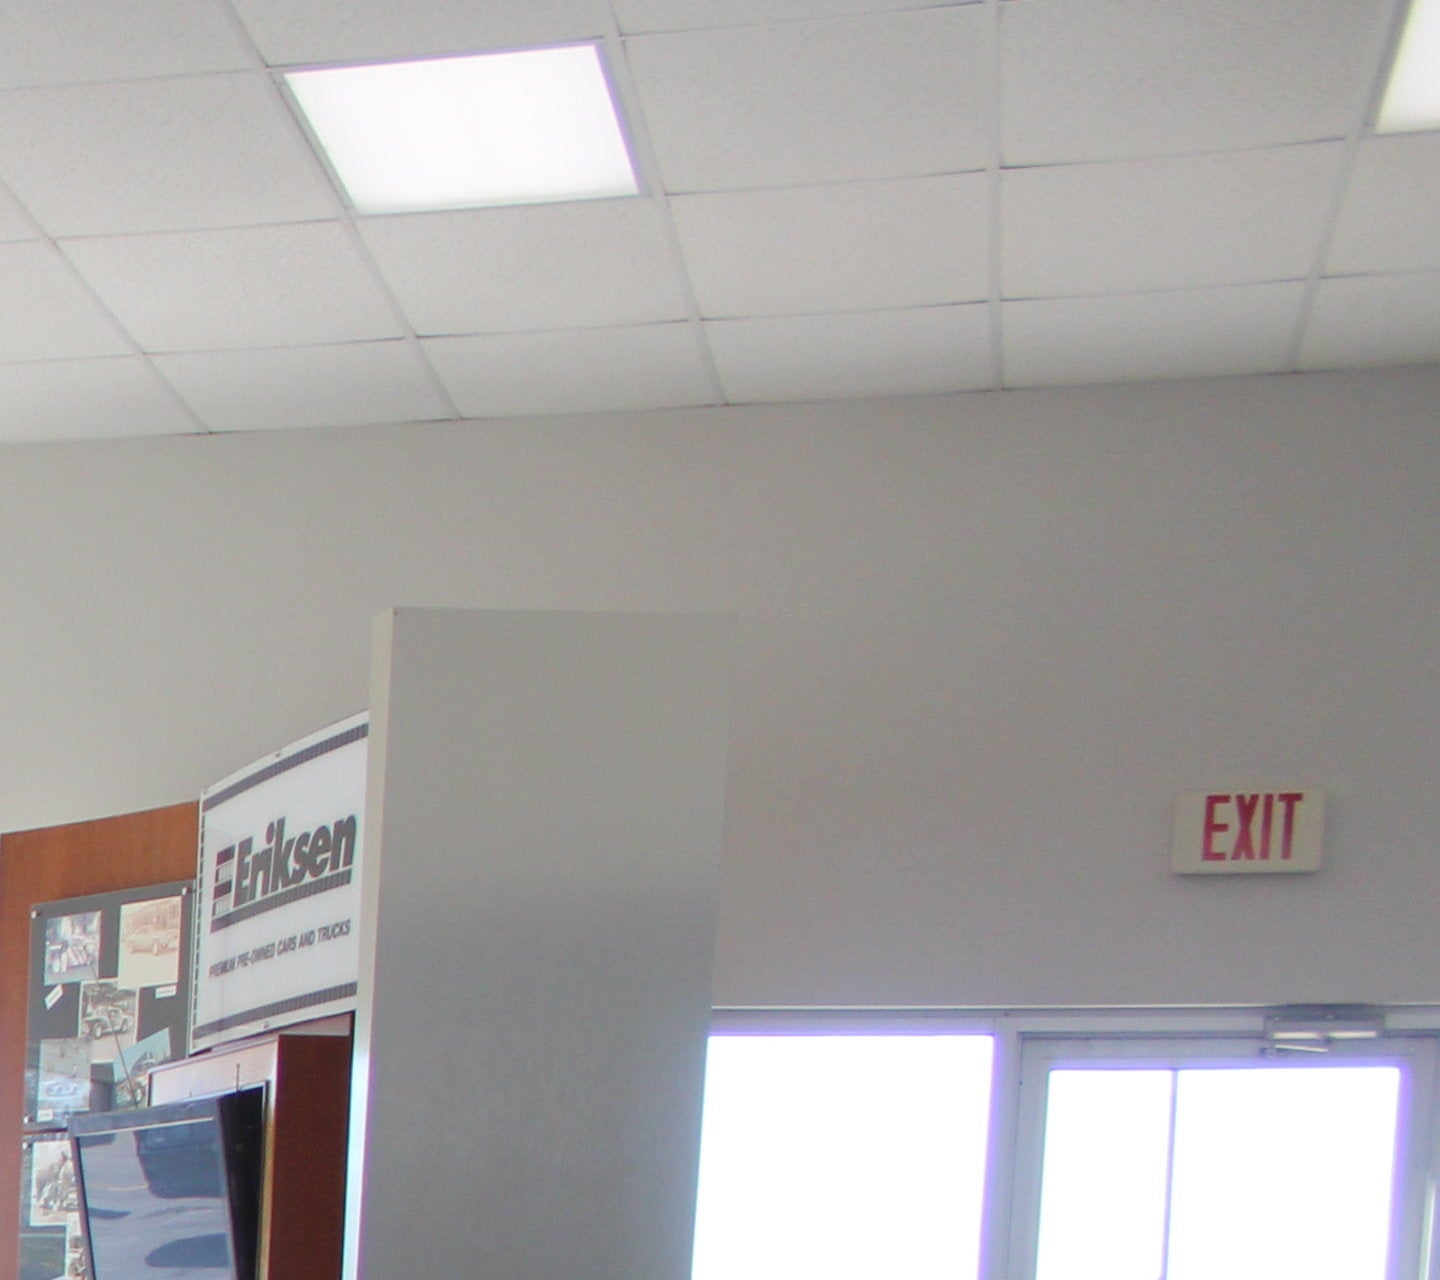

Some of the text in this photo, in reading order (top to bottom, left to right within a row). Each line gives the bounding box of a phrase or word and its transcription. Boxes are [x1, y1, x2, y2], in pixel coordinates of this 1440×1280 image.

[233, 813, 357, 909] Eriksen
[1201, 792, 1303, 861] EXIT
[277, 935, 297, 955] CARS
[298, 929, 315, 948] AND
[317, 919, 351, 942] TRUCKS
